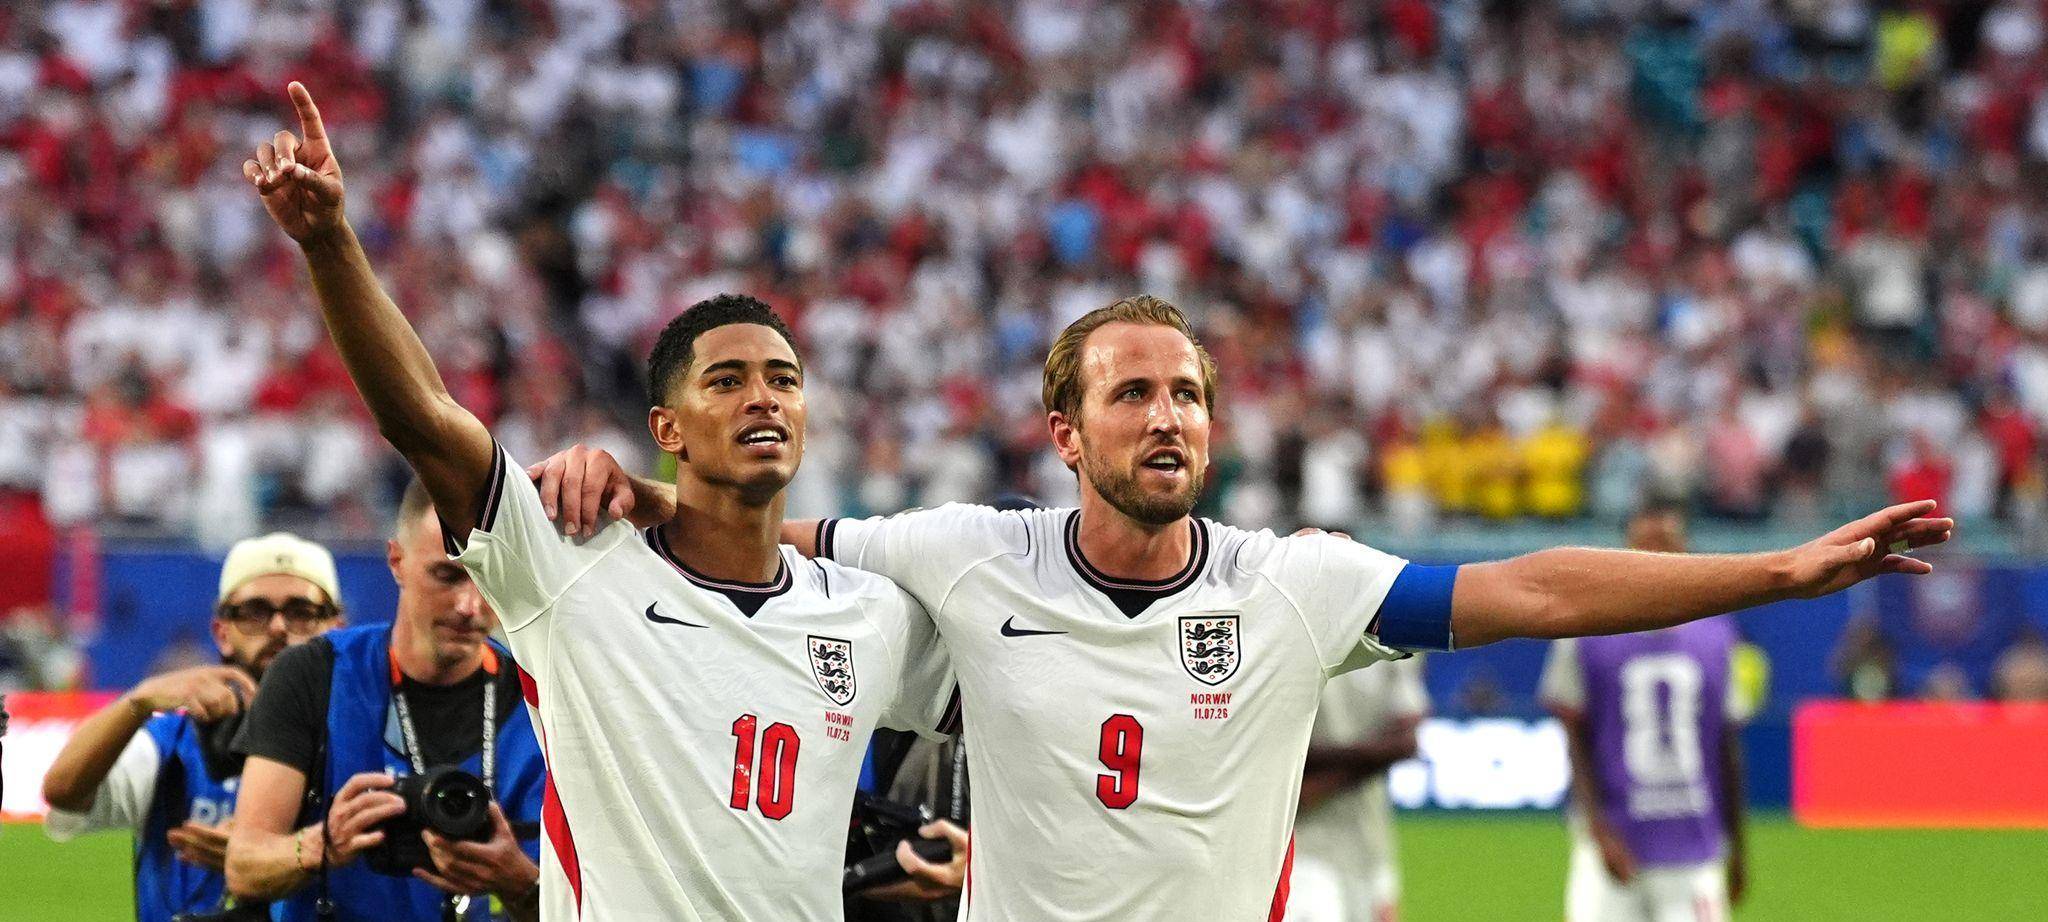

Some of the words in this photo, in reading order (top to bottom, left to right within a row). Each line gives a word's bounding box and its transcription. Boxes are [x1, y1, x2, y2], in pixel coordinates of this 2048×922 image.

[1190, 693, 1232, 705] NORWAY
[825, 711, 854, 728] NORWAY
[1194, 708, 1229, 720] 11.07.26
[729, 713, 800, 821] 10
[1096, 713, 1144, 809] 9
